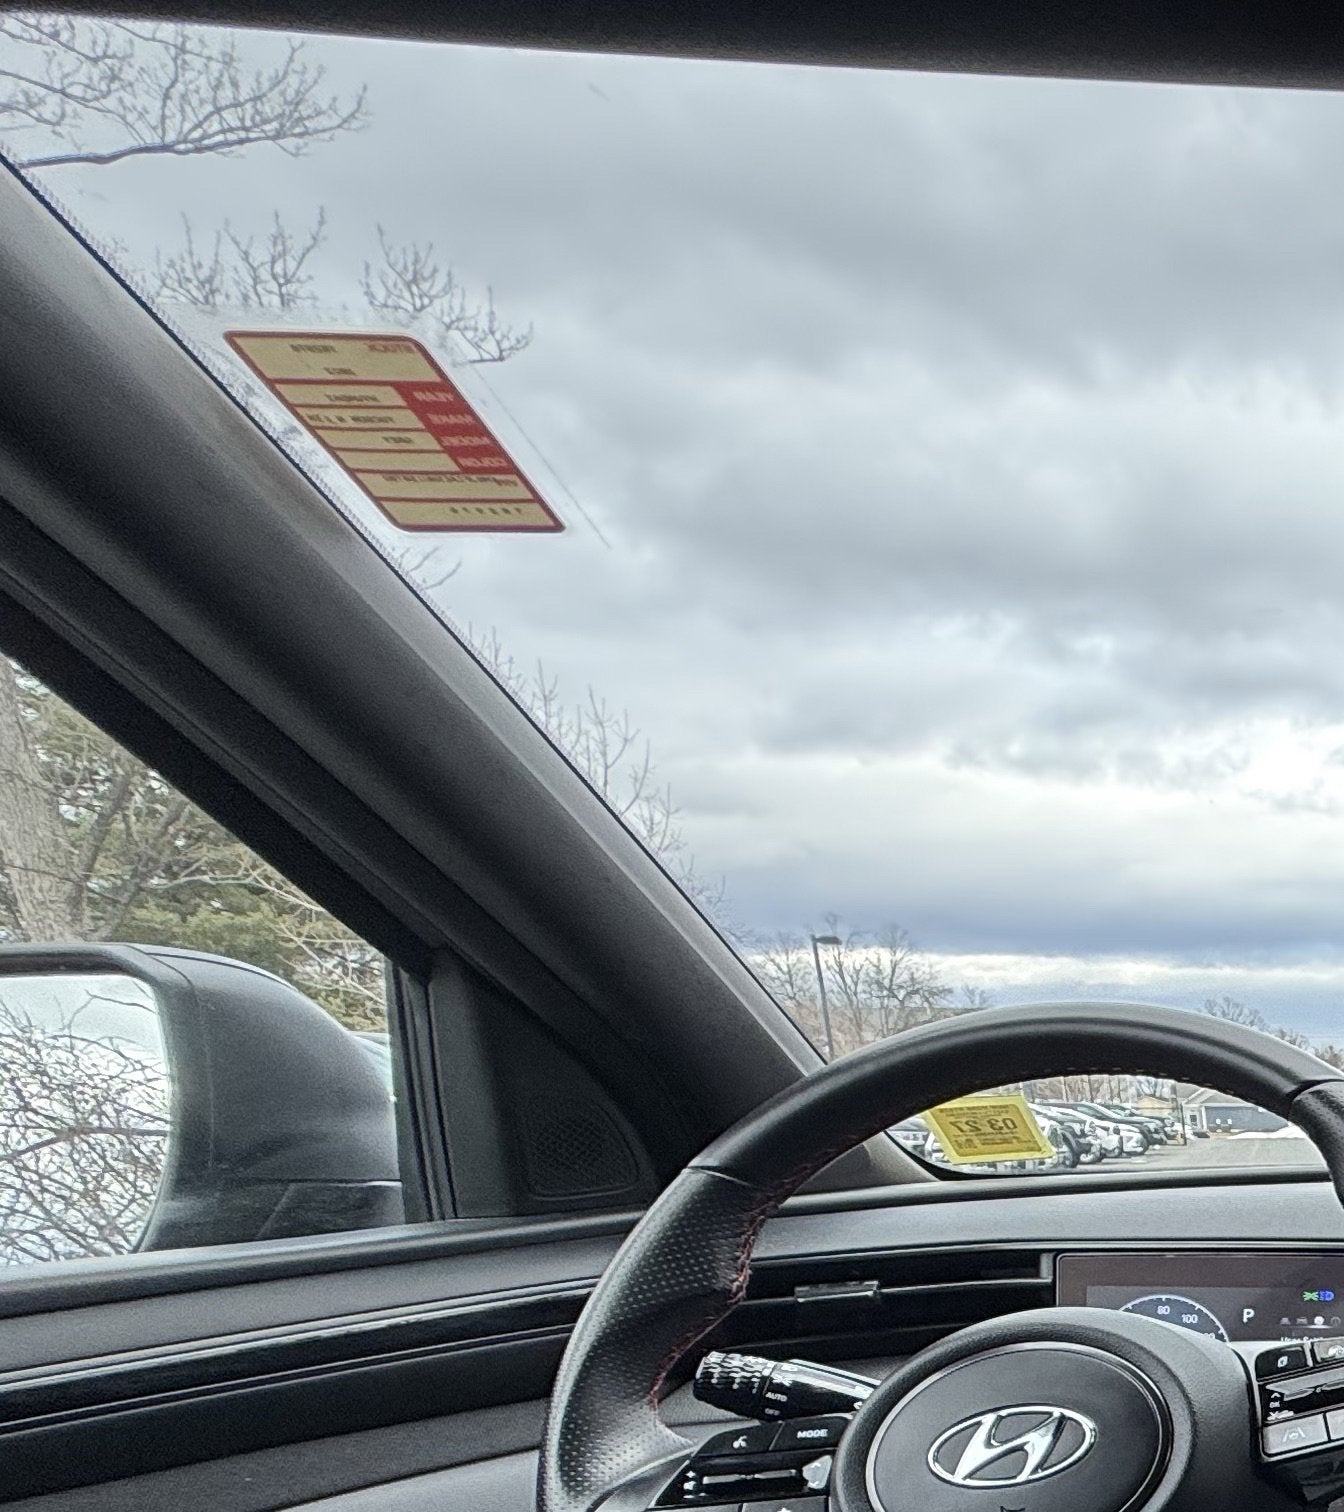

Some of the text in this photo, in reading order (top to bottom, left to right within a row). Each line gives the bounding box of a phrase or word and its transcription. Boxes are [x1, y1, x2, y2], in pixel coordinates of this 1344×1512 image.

[1157, 1305, 1171, 1315] 80
[1242, 1308, 1255, 1323] P
[1181, 1314, 1198, 1324] 100
[765, 1391, 788, 1402] AUTO
[796, 1428, 829, 1439] MODE
